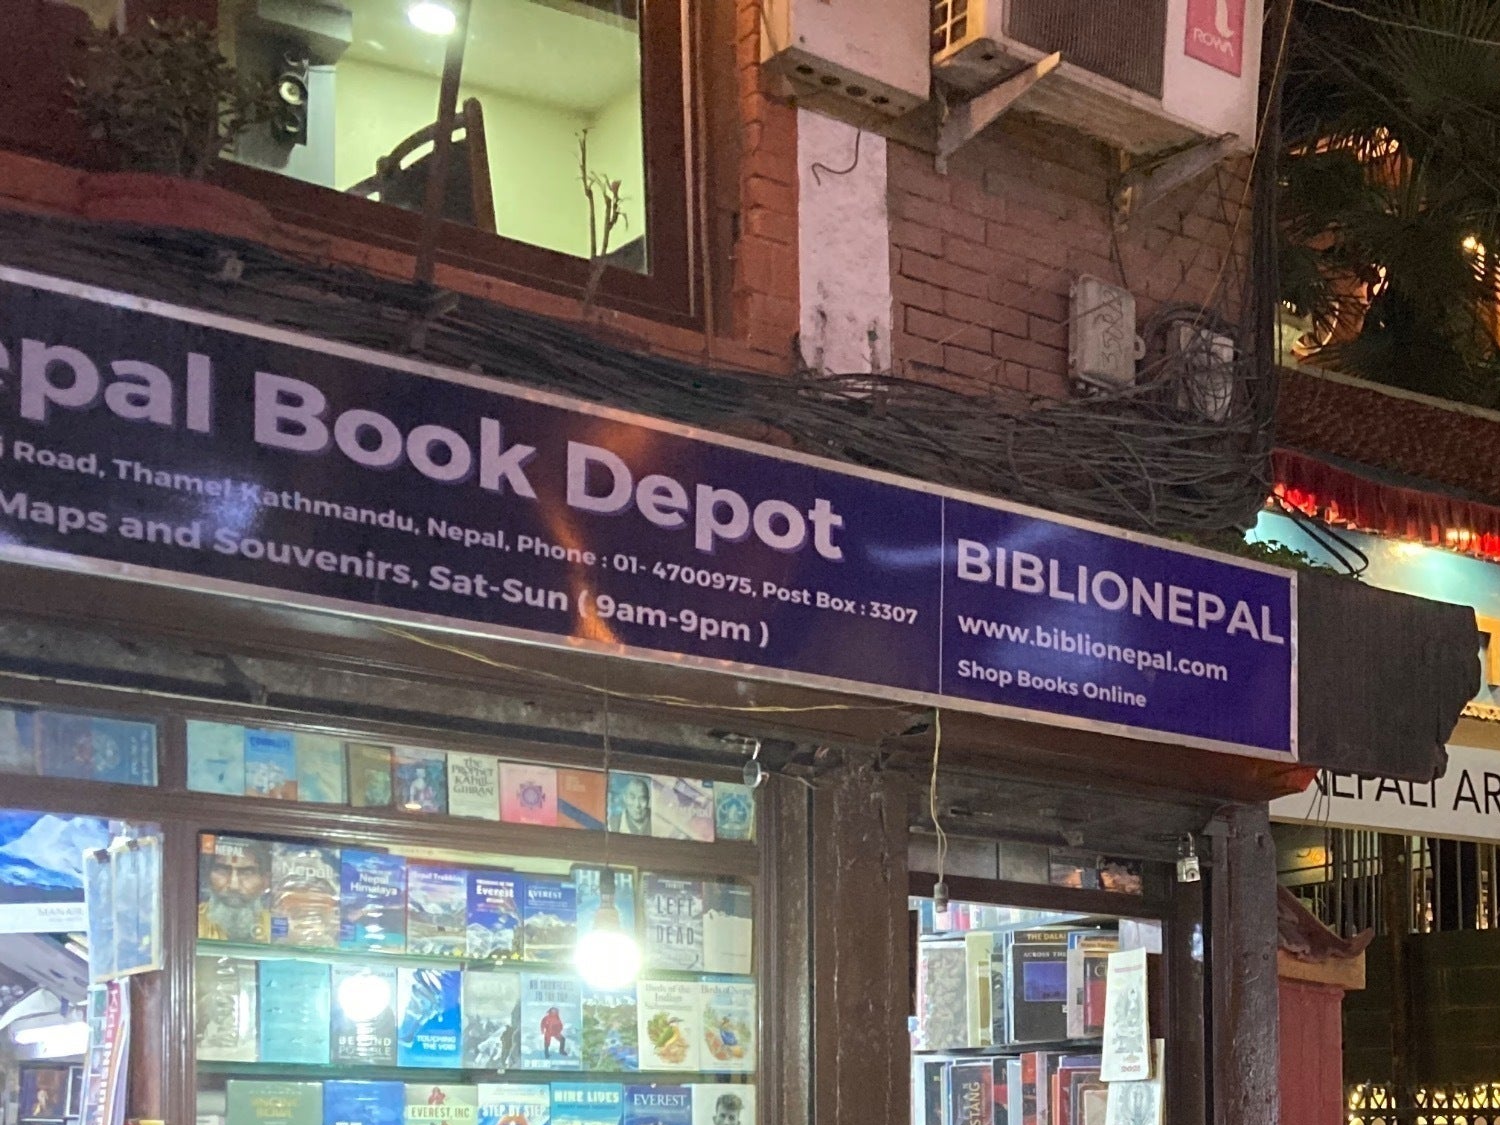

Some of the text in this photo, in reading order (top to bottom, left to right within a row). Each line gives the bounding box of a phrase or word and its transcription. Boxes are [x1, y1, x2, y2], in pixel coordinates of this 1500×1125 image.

[0, 337, 845, 560] pal Book Depot
[13, 440, 106, 478] Road,
[112, 458, 232, 497] Thamel
[240, 484, 420, 535] Kathmandu,
[427, 517, 510, 551] Nepal,
[516, 535, 595, 566] Phone
[652, 561, 757, 598] 4700975,
[763, 581, 812, 606] Post
[816, 591, 856, 615] Box
[869, 601, 918, 625] 3307
[0, 490, 751, 642] Maps and Souvenirs, Sat-Sun 9am-9pm
[957, 538, 1285, 645] BIBLIONEPAL
[957, 615, 1229, 682] www.biblionepal.com
[958, 659, 1147, 708] Shop Books Online
[350, 882, 398, 897] Himalaya
[359, 873, 390, 887] Nepal
[476, 885, 515, 899] Everest
[528, 889, 562, 899] EVEREST
[656, 896, 694, 917] LEFT
[656, 926, 695, 946] DEAD
[554, 1090, 619, 1104] NINE LIVES
[633, 1094, 686, 1107] EVEREST
[482, 1104, 547, 1118] STEP BY STEP
